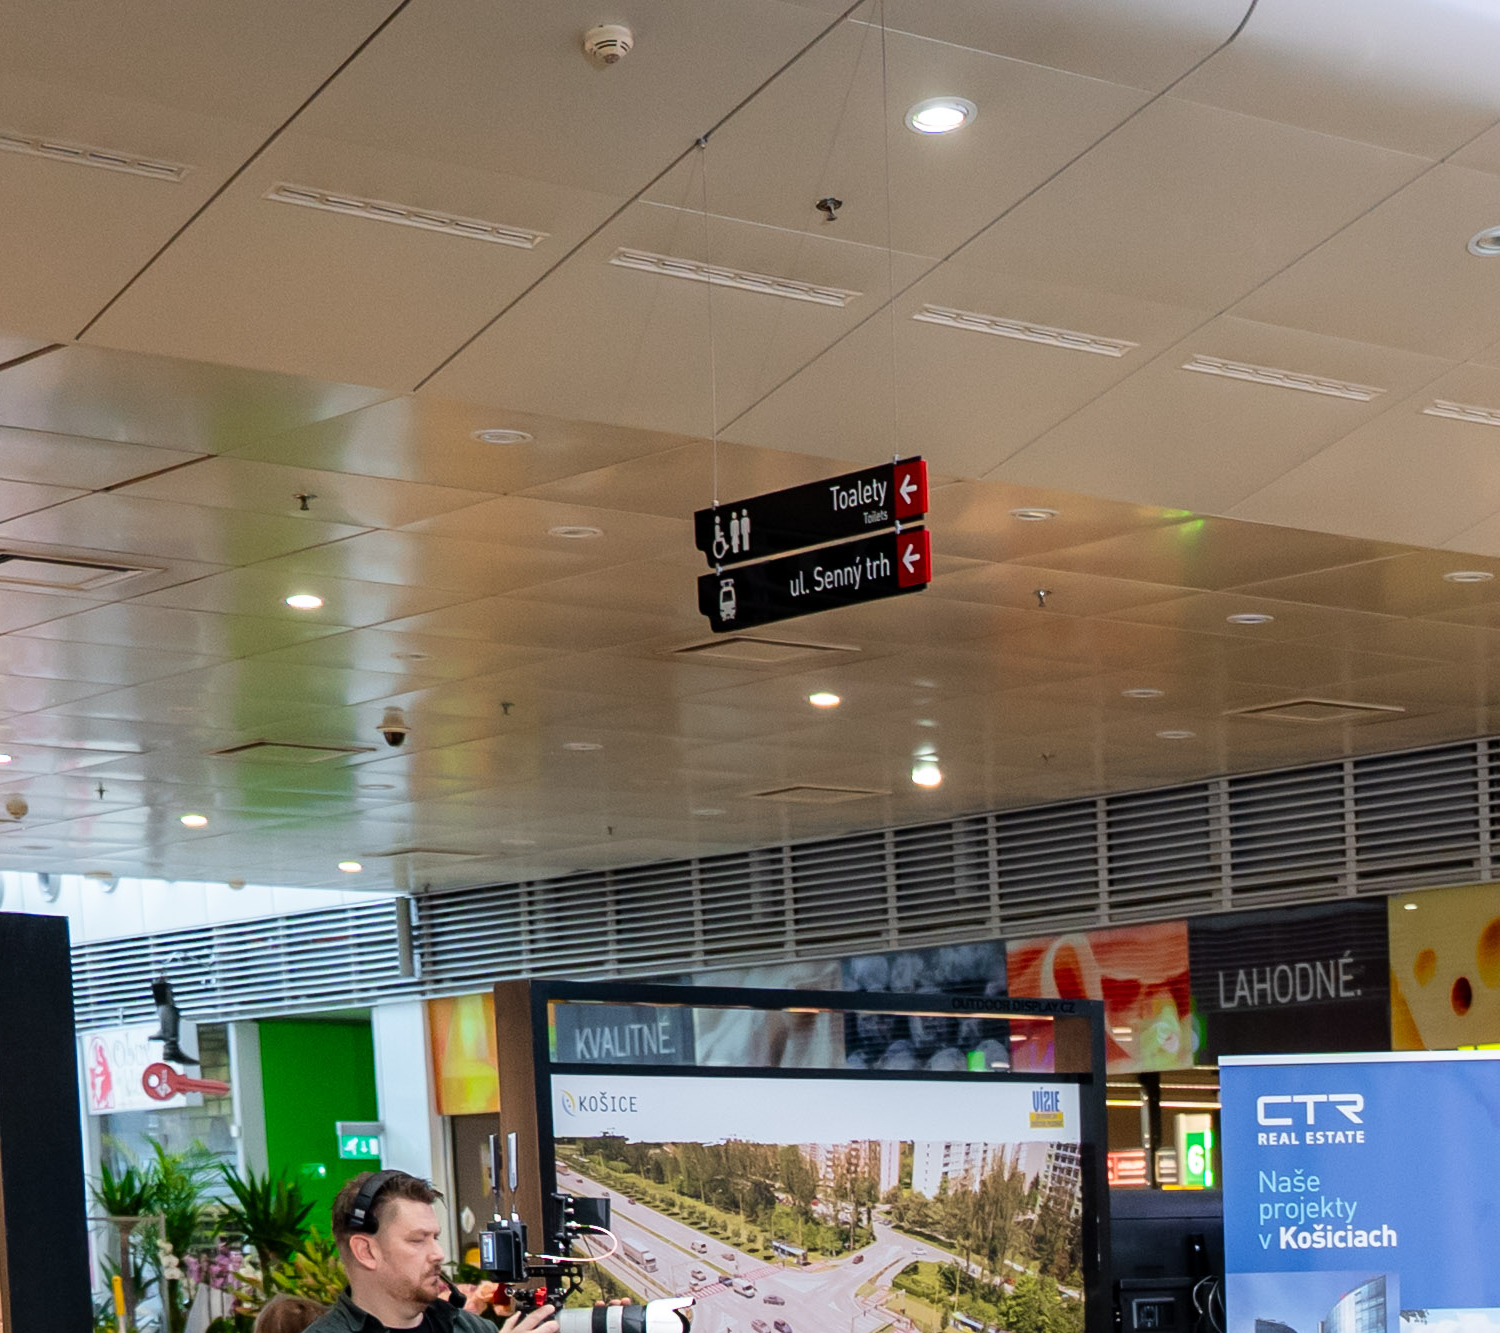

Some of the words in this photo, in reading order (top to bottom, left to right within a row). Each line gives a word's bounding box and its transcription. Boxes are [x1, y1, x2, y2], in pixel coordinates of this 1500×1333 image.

[830, 479, 887, 511] Toalety
[863, 511, 888, 525] Toilets
[790, 570, 809, 597] ul.
[813, 556, 862, 592] Senný
[865, 552, 890, 581] trh
[1218, 950, 1362, 1009] LAHODNÉ.
[952, 998, 1010, 1011] OUTDOOR
[1012, 1000, 1076, 1013] DISPLAY.CZ
[578, 1091, 638, 1113] KOŠICE
[1256, 1093, 1365, 1126] CTR
[1257, 1132, 1300, 1146] REAL
[1305, 1130, 1366, 1145] ESTATE
[1187, 1144, 1205, 1175] 6
[1259, 1168, 1320, 1193] Naše
[1259, 1196, 1358, 1226] projekty
[1258, 1233, 1272, 1250] v
[1279, 1224, 1398, 1250] Košiciach
